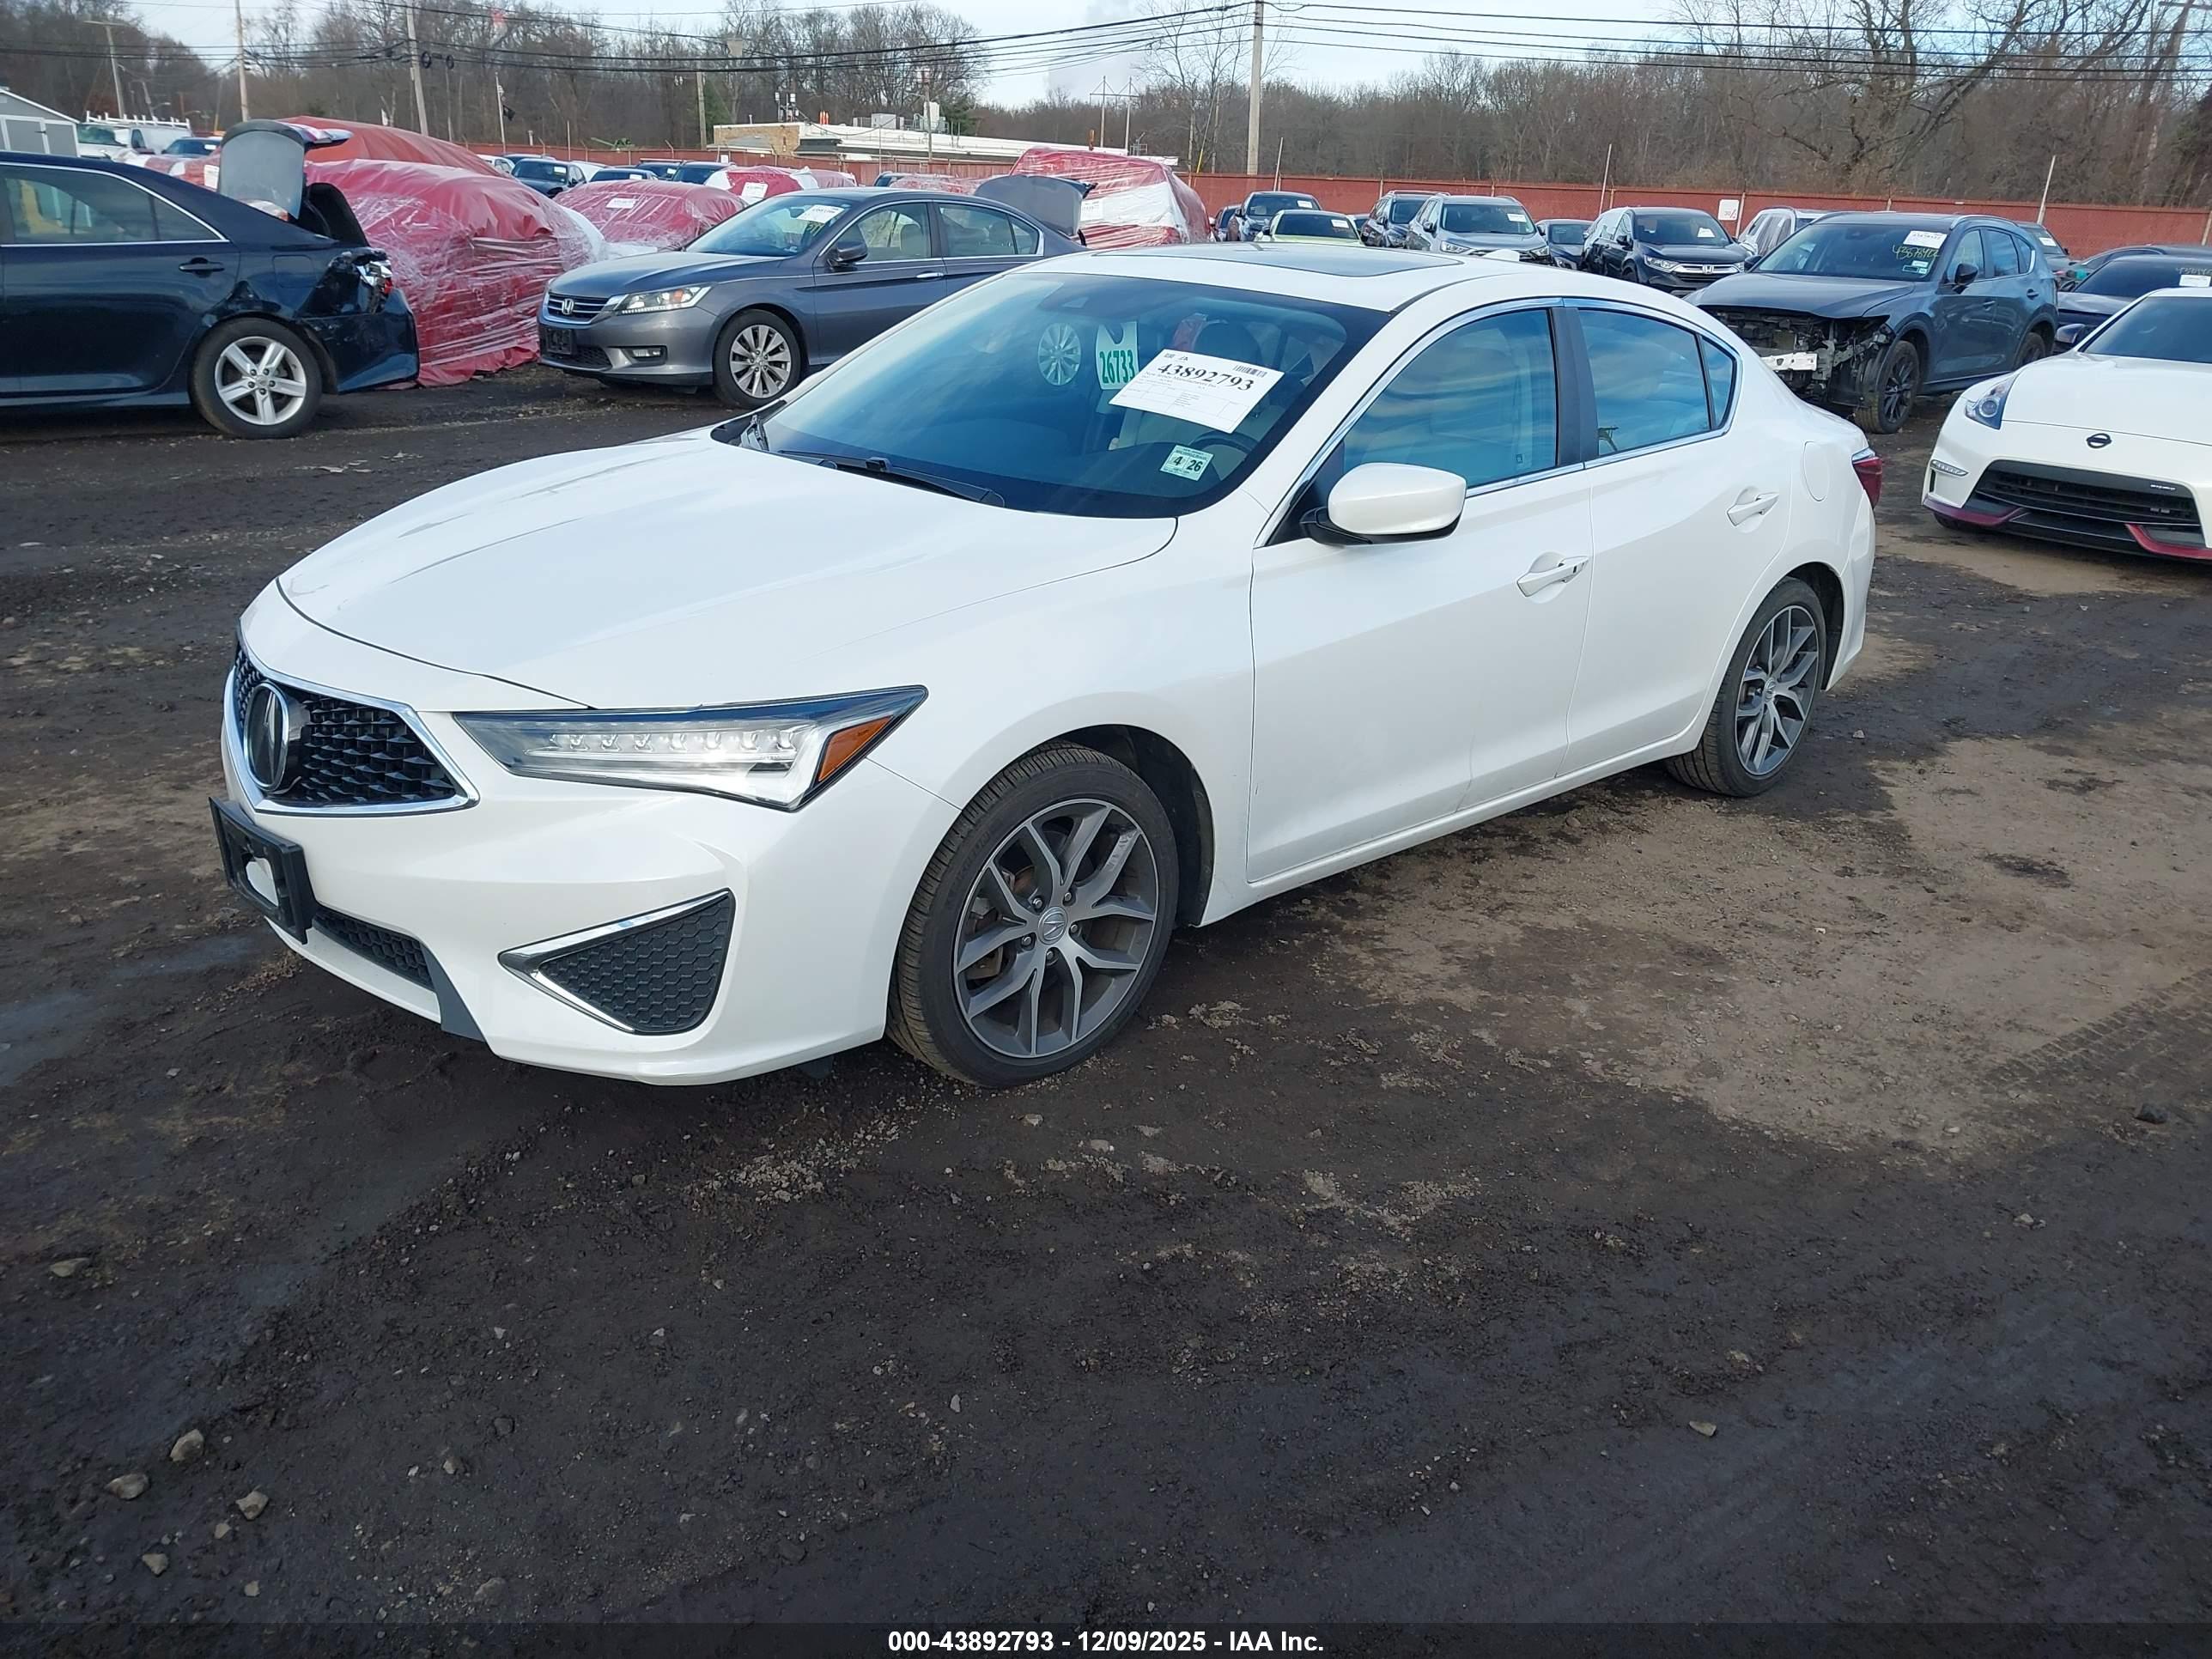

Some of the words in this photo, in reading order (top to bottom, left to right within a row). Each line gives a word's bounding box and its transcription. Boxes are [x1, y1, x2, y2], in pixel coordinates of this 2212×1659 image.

[1099, 349, 1135, 384] 26733
[1158, 363, 1255, 391] 43892793
[1174, 456, 1183, 466] 4
[1187, 459, 1203, 472] 26
